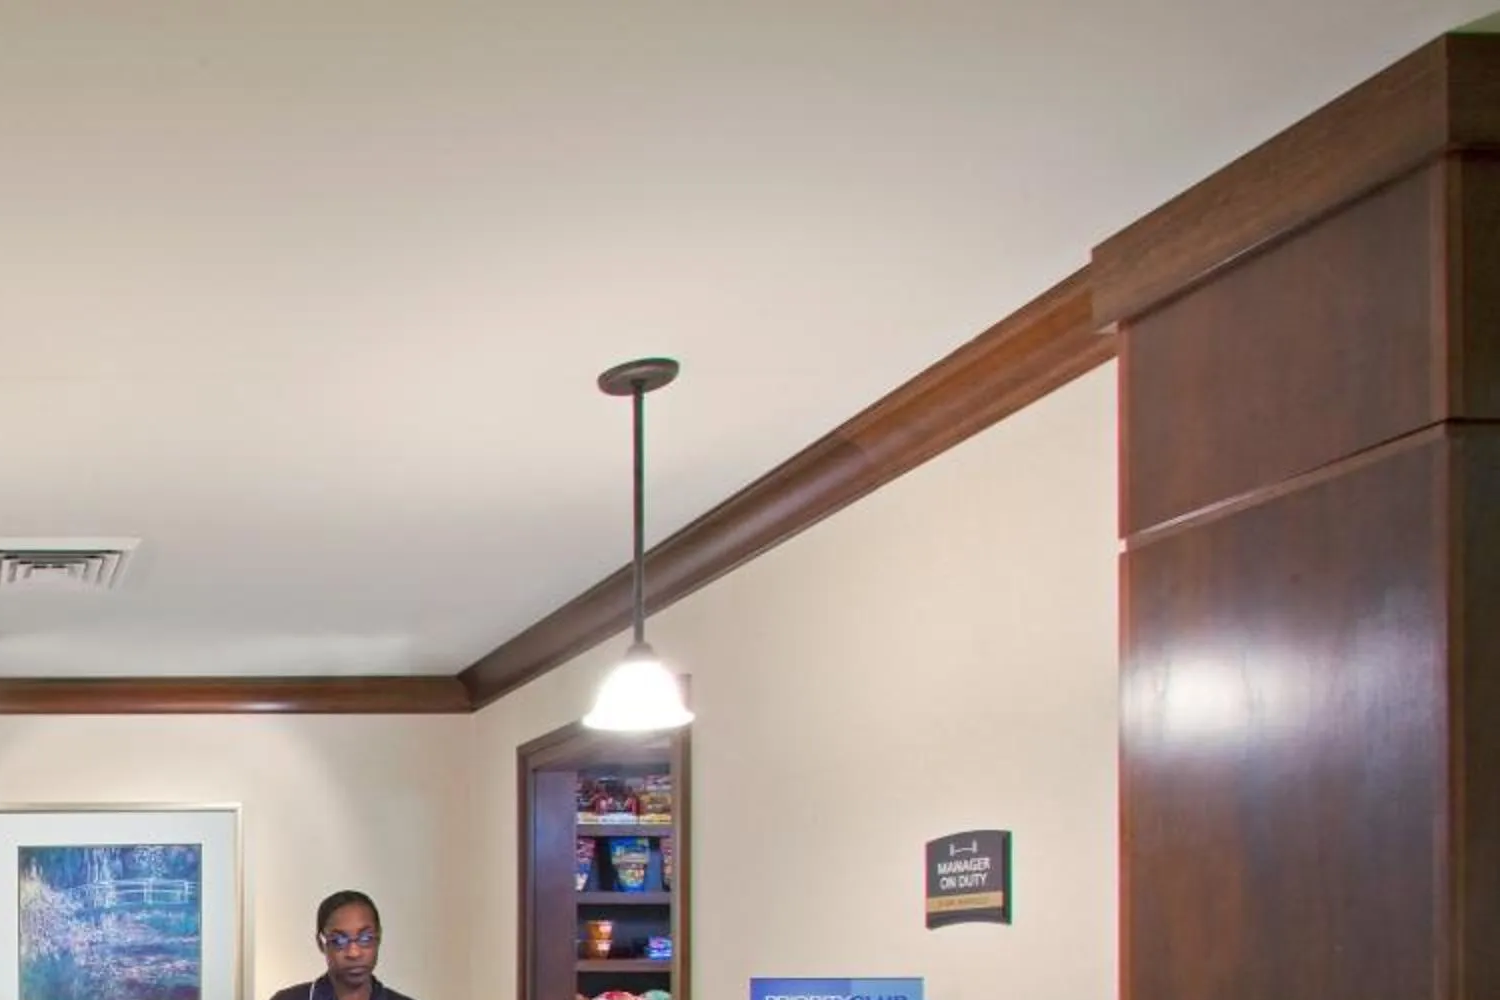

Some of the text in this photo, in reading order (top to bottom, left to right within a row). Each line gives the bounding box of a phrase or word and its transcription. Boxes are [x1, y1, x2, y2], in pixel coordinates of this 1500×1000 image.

[937, 857, 991, 875] MANAGER
[940, 872, 989, 890] ON DUTY
